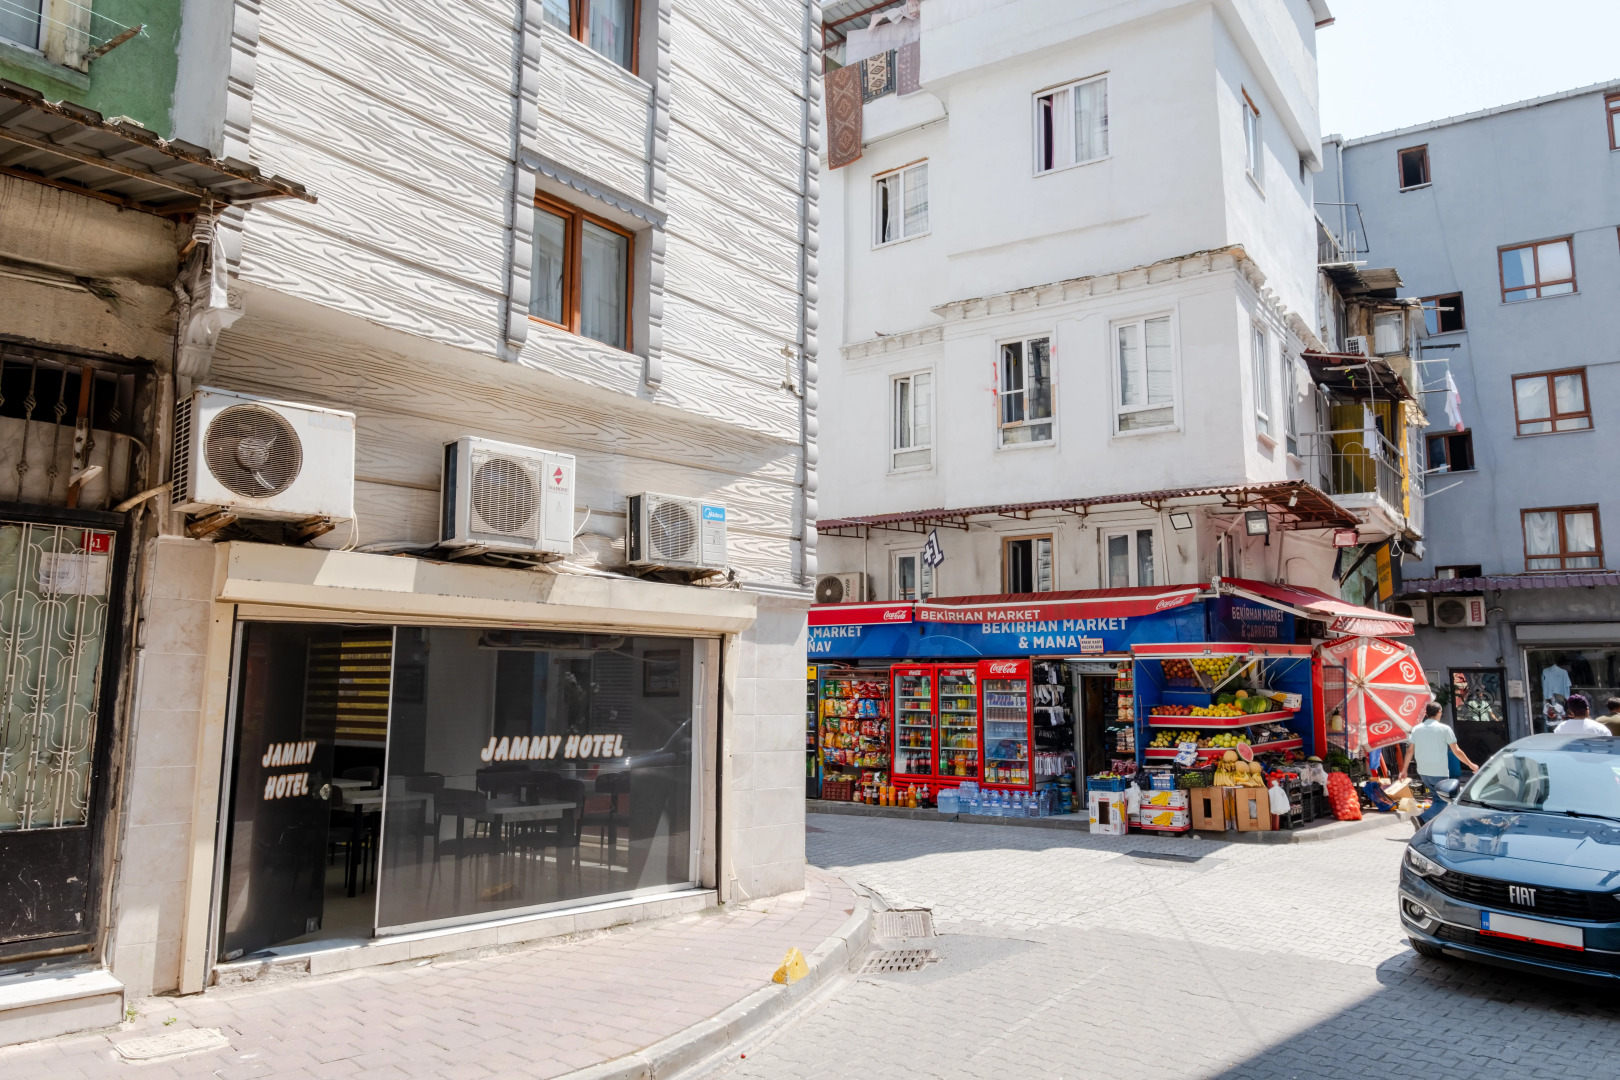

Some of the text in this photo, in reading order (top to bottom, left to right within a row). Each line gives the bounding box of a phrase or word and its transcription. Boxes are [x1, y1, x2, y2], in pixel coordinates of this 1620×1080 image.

[883, 609, 907, 621] Coca-Cola
[920, 609, 1041, 621] BEKİRHAN MARKET
[1262, 608, 1284, 622] MARKET
[1063, 617, 1128, 632] MARKET
[813, 625, 863, 639] MARKET
[1018, 636, 1029, 649] &
[989, 662, 1017, 674] Coca-Cola
[262, 740, 317, 768] JAMMY
[480, 734, 624, 762] JAMMY HOTEL
[264, 771, 309, 801] HOTEL
[1508, 884, 1537, 907] FIAT
